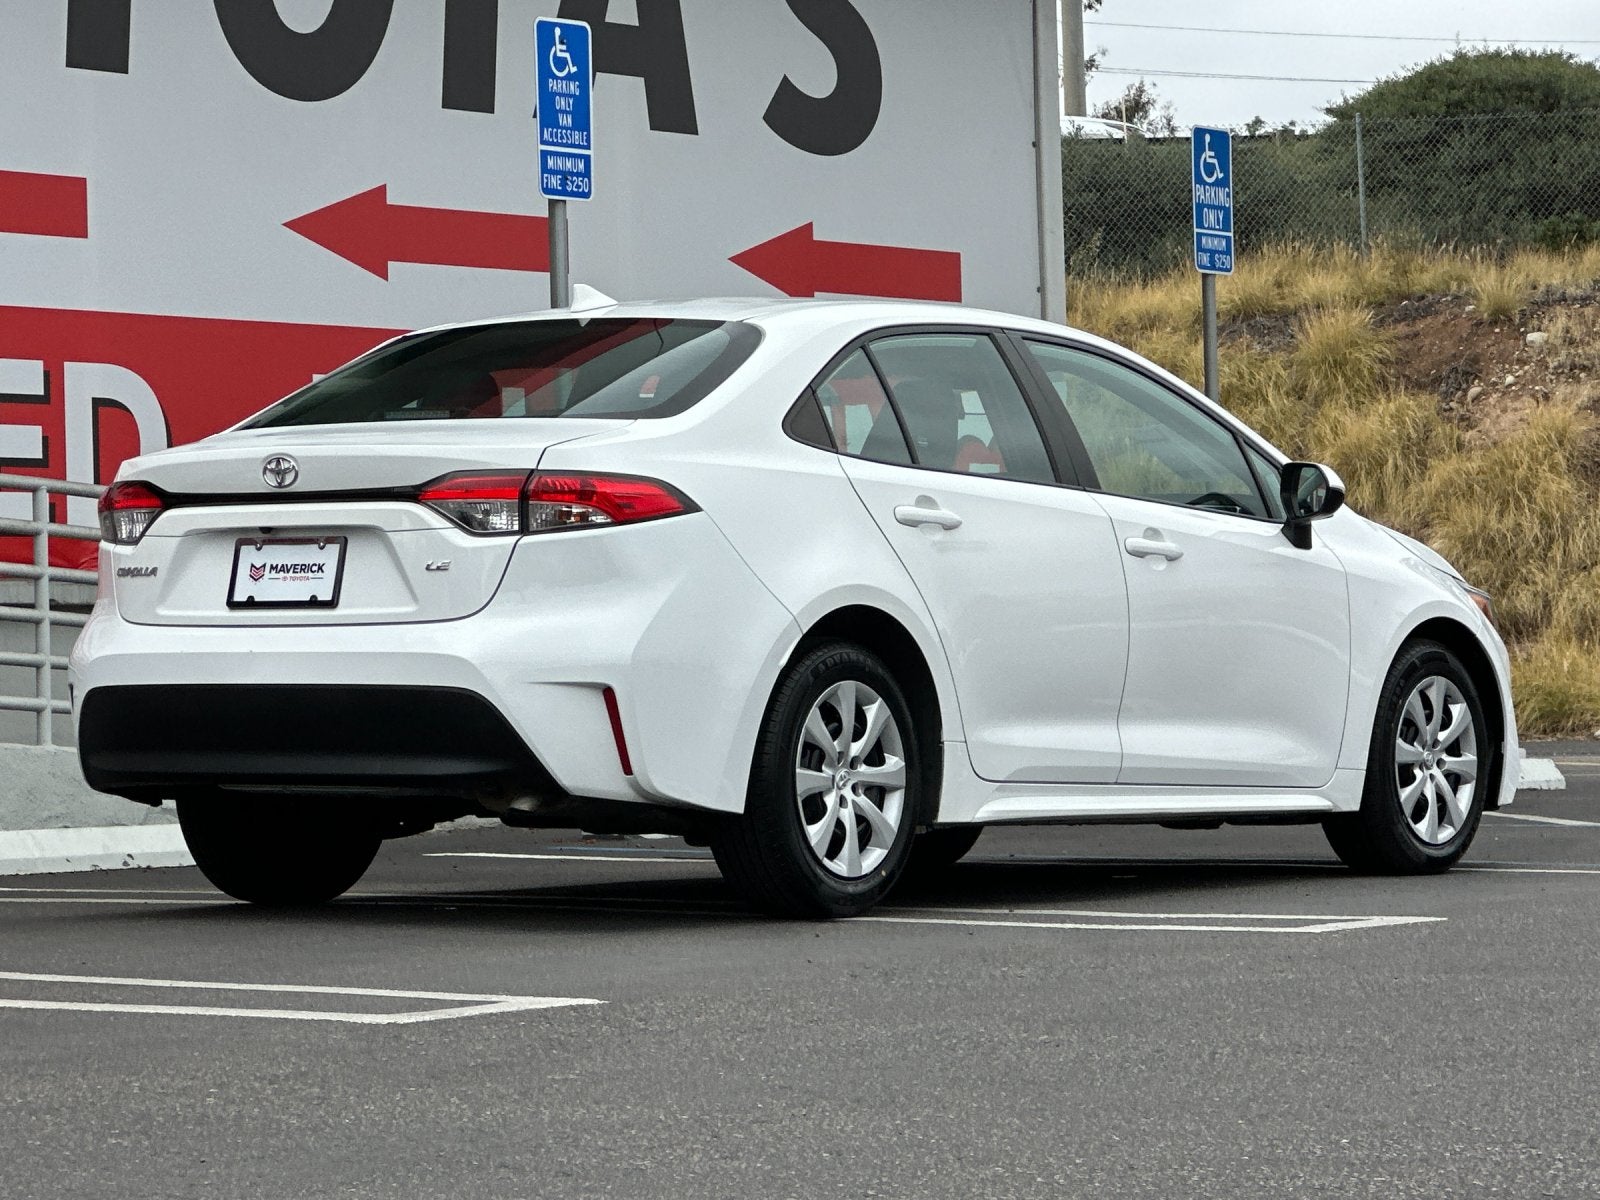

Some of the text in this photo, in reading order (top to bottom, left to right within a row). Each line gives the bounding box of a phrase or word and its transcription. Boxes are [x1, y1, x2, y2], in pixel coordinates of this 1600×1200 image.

[548, 79, 580, 96] PARKING
[555, 96, 574, 111] ONLY
[558, 113, 573, 128] VAN
[543, 128, 588, 146] ACCESSIBLE
[547, 155, 585, 174] MINIMUM
[543, 174, 589, 193] FINE $250
[1195, 184, 1230, 208] PARKING
[1203, 208, 1224, 230] ONLY
[1201, 236, 1226, 251] MINIMUM
[1198, 252, 1231, 269] FINE $250
[269, 562, 327, 575] MAVERICK
[425, 560, 452, 572] LE
